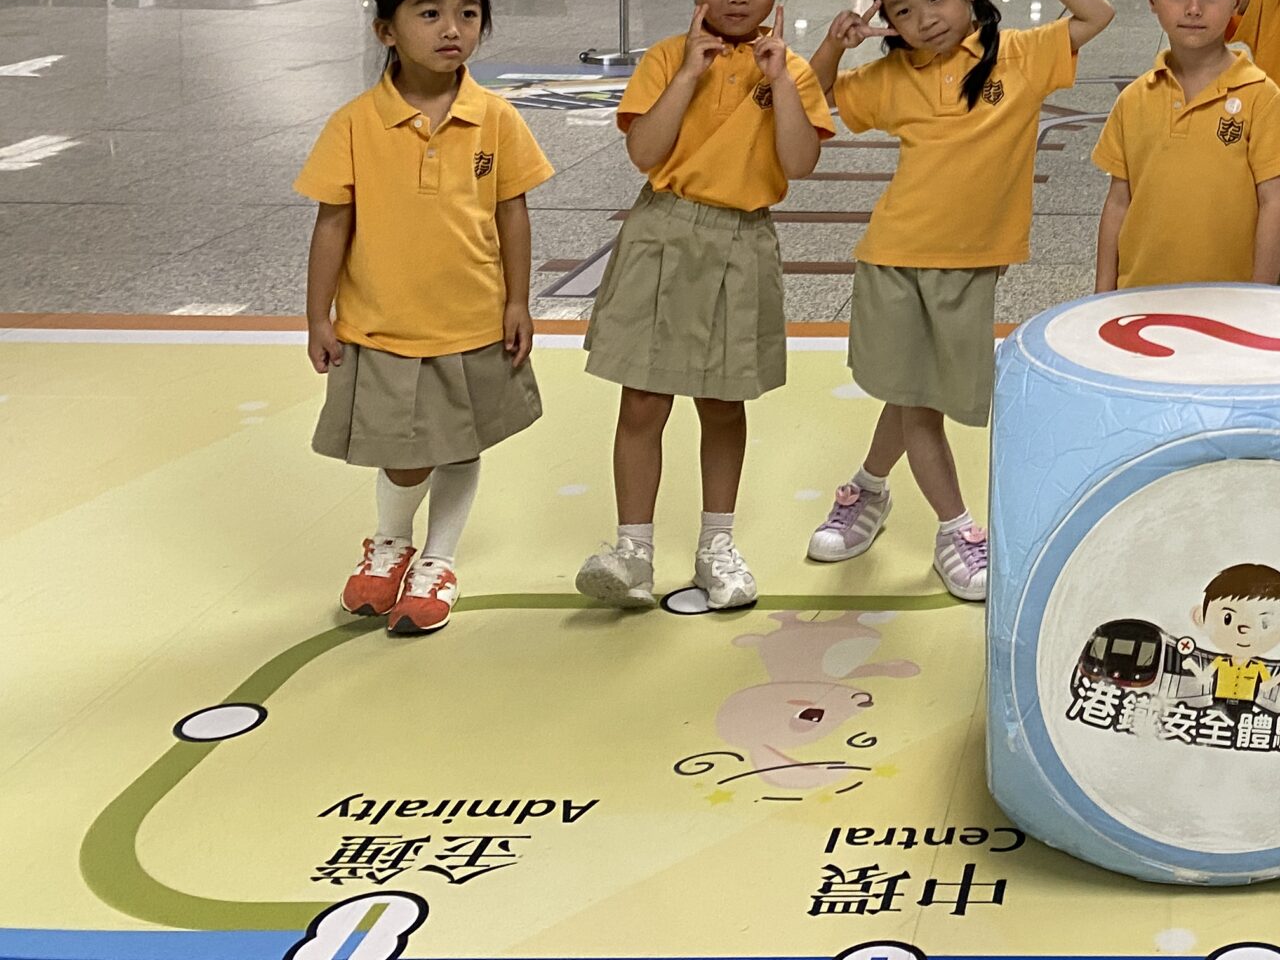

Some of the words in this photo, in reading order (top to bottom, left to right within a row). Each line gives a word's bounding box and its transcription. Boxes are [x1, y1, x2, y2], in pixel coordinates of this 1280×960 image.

[317, 793, 600, 825] Admiralty
[310, 835, 532, 886] 金鐘
[824, 827, 1026, 853] Central
[807, 863, 1008, 917] 中環
